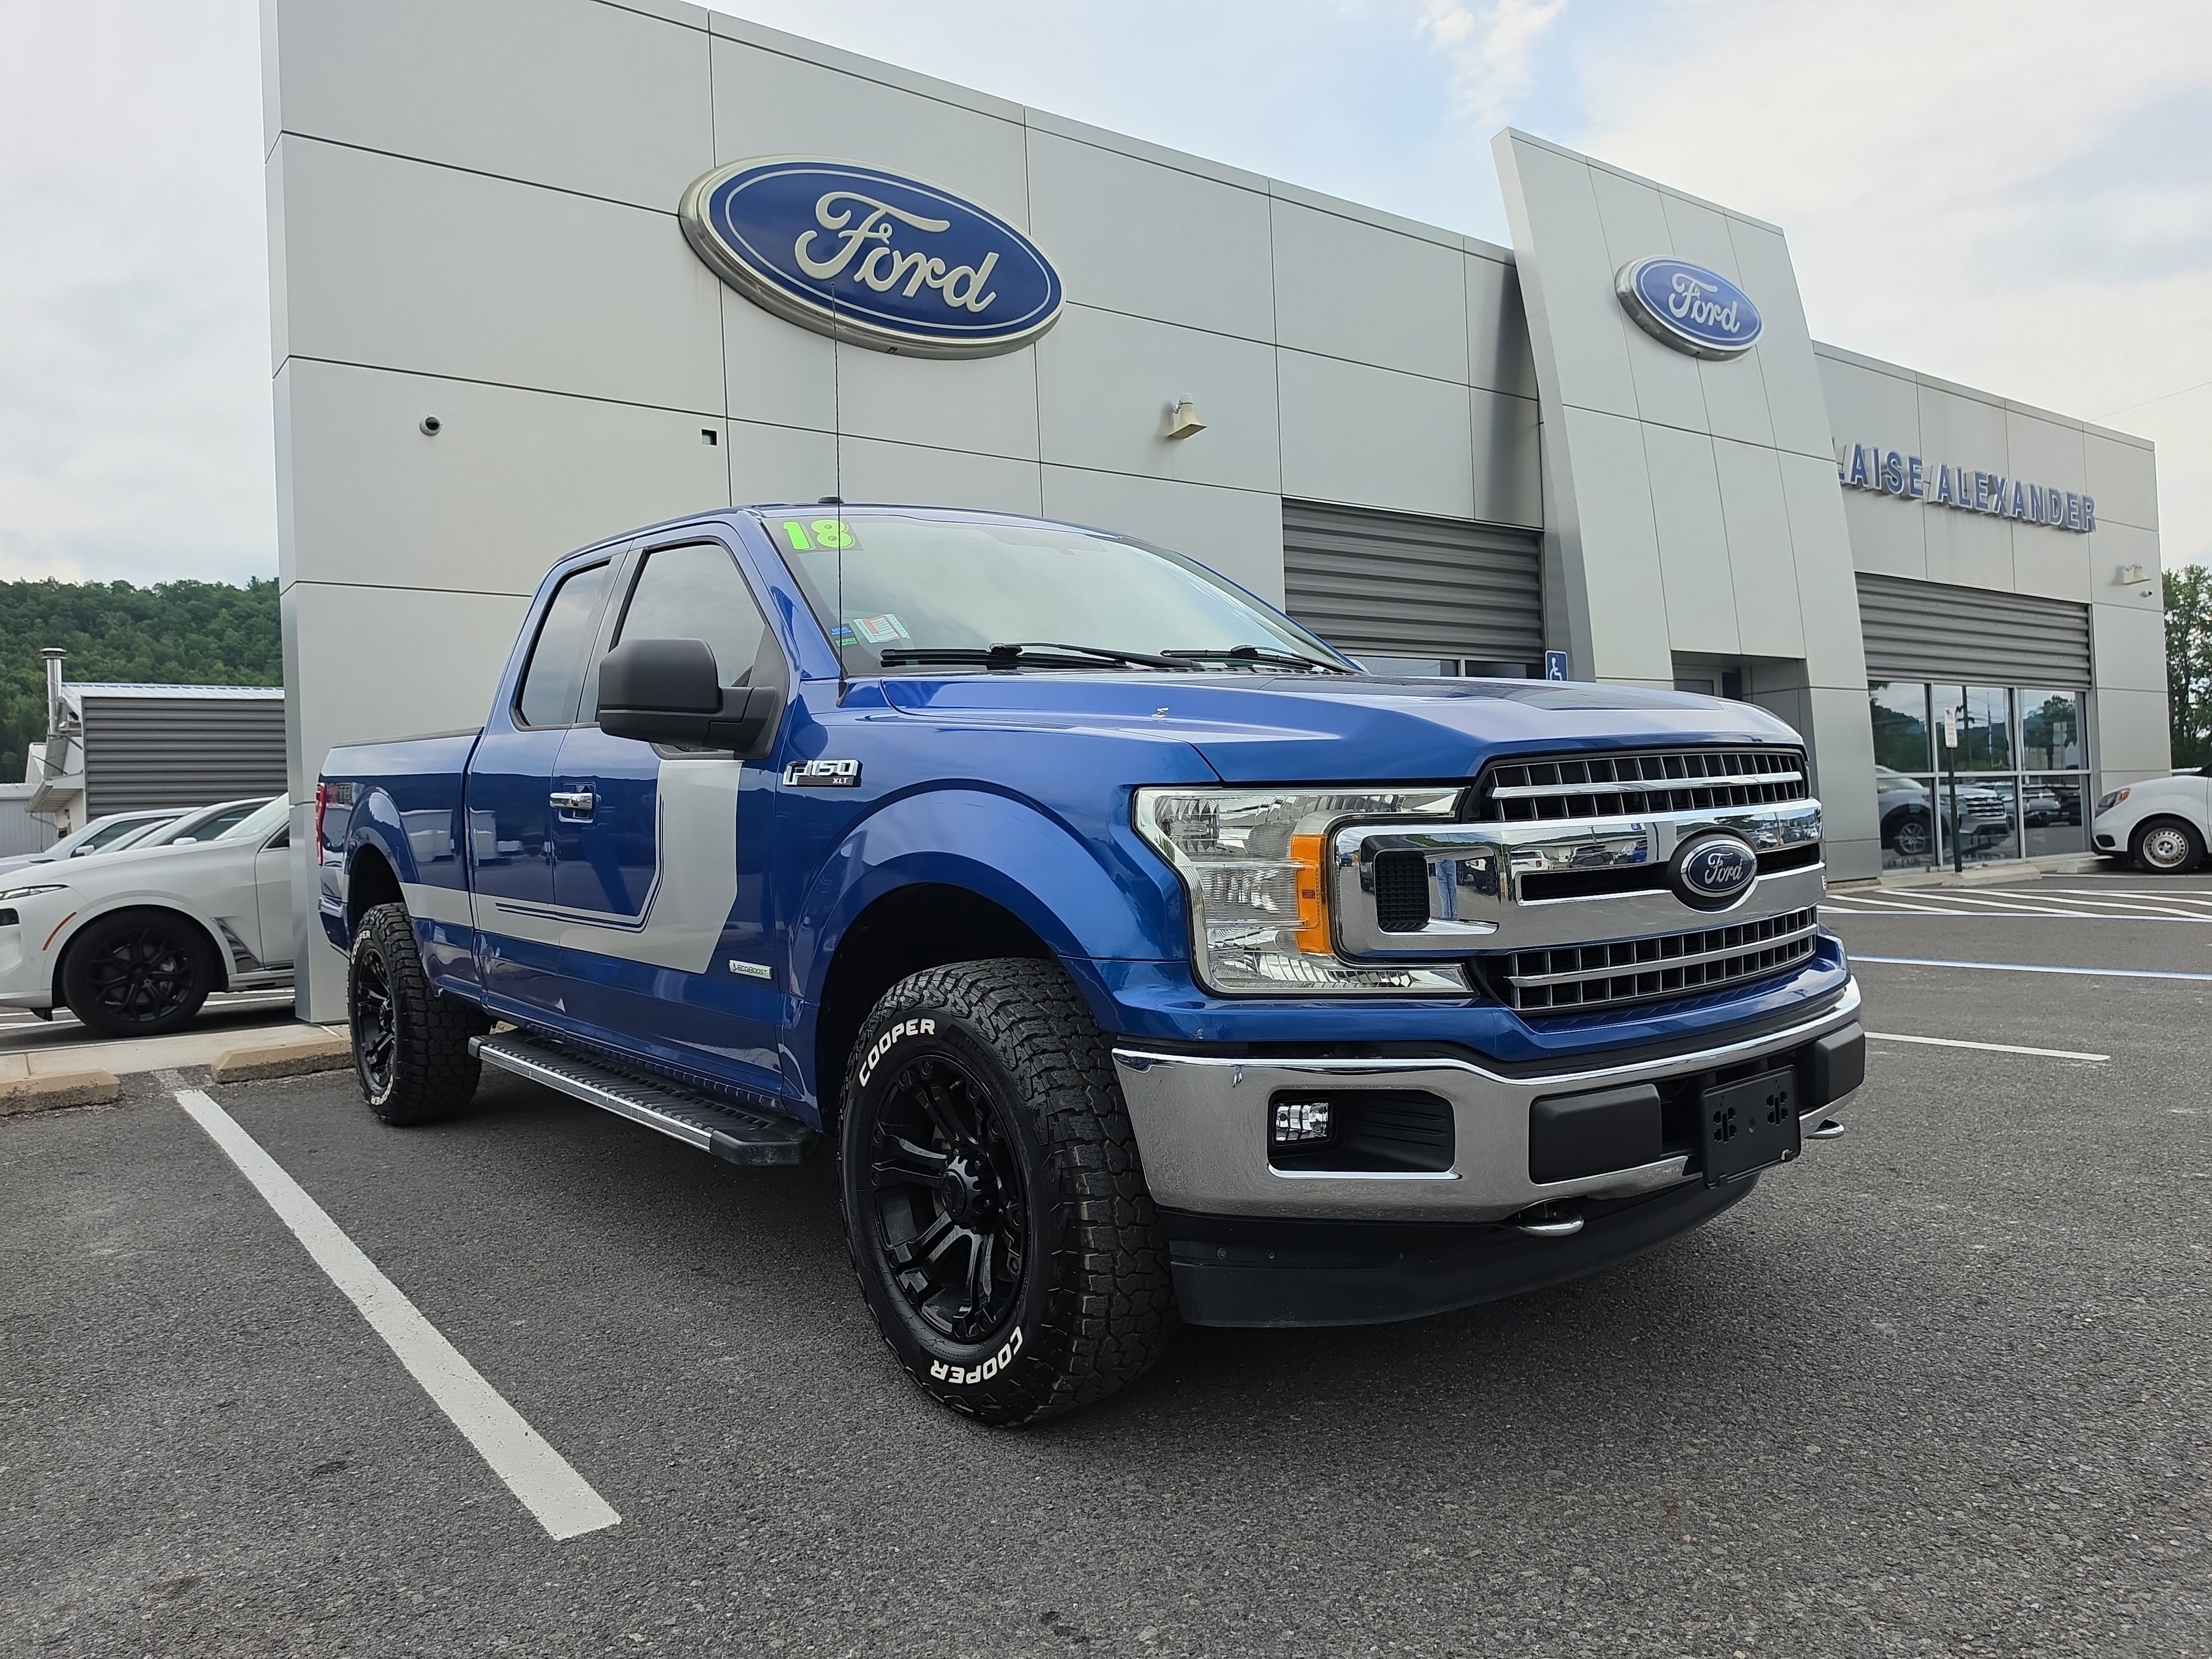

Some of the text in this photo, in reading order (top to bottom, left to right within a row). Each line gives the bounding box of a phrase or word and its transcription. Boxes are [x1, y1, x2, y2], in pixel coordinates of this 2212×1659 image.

[794, 191, 1000, 313] Ford
[1668, 273, 1740, 333] Ford
[1930, 462, 2096, 532] ALEXANDER
[783, 519, 854, 550] 18
[1705, 852, 1743, 884] Ford
[351, 930, 371, 965] COOPER
[859, 1018, 935, 1087] COOPER
[930, 1326, 1023, 1384] COOPER
